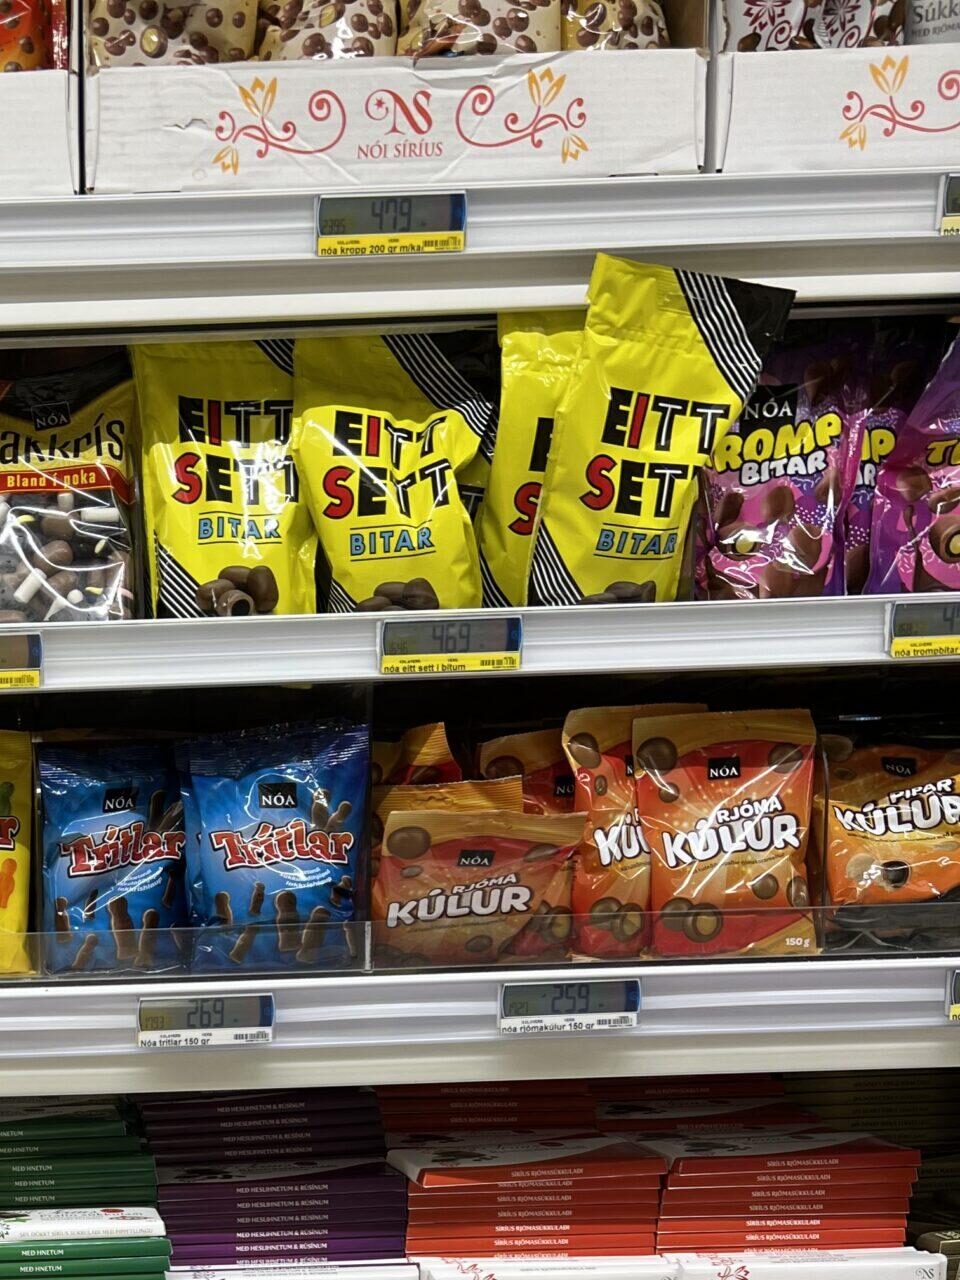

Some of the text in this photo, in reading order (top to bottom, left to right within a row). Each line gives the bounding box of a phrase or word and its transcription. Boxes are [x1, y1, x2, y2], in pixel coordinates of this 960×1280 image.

[357, 139, 444, 159] NÓI SÍRÍUS
[371, 199, 411, 233] 479
[321, 244, 385, 255] nóa 200
[35, 410, 69, 430] NÓA
[178, 395, 293, 445] EITT
[600, 387, 730, 456] EITT
[333, 410, 448, 461] EITT
[7, 472, 42, 489] Bland
[64, 469, 97, 487] poka
[740, 454, 827, 487] BITAR
[323, 461, 449, 519] SETT
[197, 516, 282, 541] BITAR
[349, 526, 433, 556] BITAR
[594, 528, 677, 557] BITAR
[384, 663, 433, 673] nóa sett
[710, 764, 739, 778] NÓA
[104, 795, 135, 811] NÓA
[261, 793, 296, 808] NÓA
[717, 796, 782, 825] RJÓMA
[62, 823, 186, 879] Trítlar
[210, 817, 355, 870] Trítlar
[661, 812, 800, 869] KÚLUR
[459, 854, 491, 868] NÓA
[452, 872, 517, 895] RJÓMA
[386, 884, 534, 930] KÚLUR
[785, 937, 802, 948] 150
[552, 986, 589, 1012] 259
[187, 1000, 224, 1029] 269
[141, 1039, 157, 1047] Nóa
[21, 1248, 64, 1257] MEÐ HNETUM
[20, 1264, 62, 1273] MEÐ HNETUM
